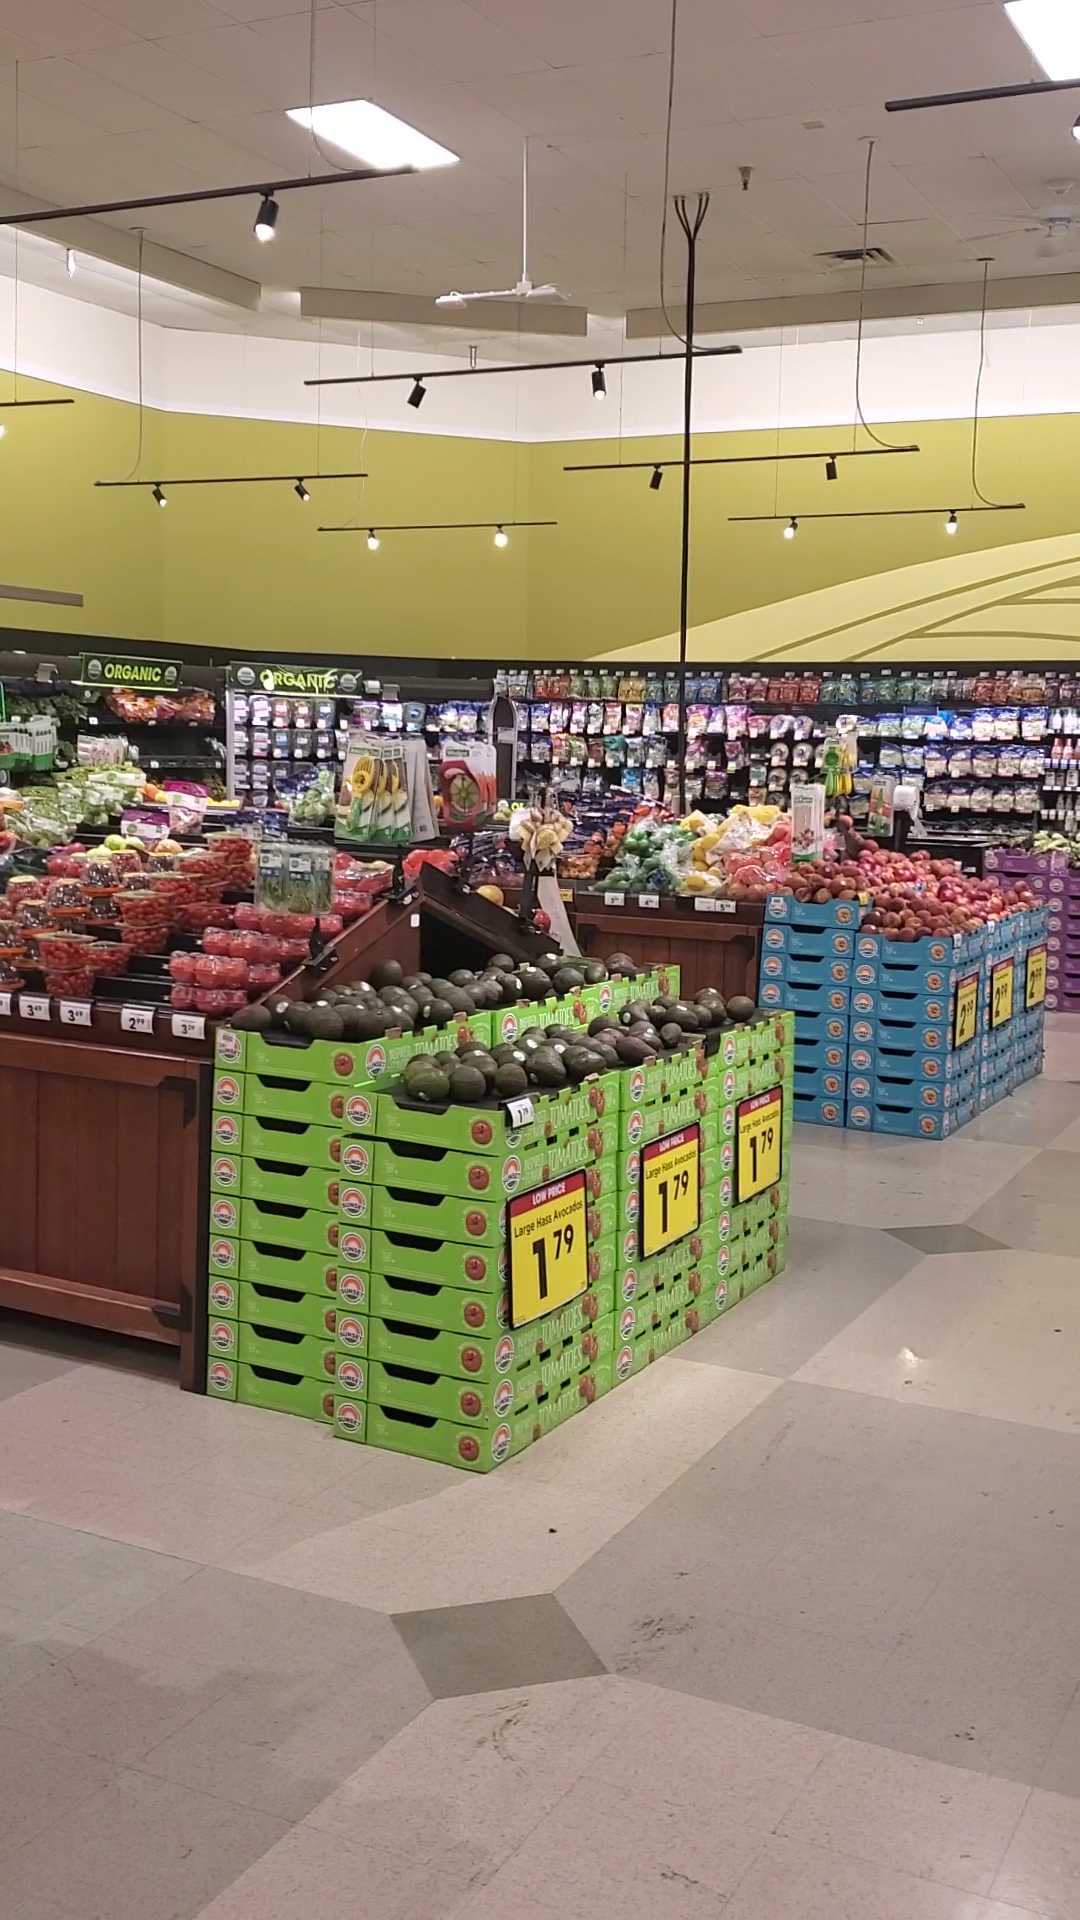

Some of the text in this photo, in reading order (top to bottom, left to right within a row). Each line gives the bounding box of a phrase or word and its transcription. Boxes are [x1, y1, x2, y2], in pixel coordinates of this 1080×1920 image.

[104, 662, 162, 682] ORGANIC
[347, 1110, 370, 1120] SUNSET
[550, 1094, 590, 1129] TOMATOES
[548, 1136, 589, 1172] TOMATOES
[659, 1132, 685, 1152] LOW PRICE
[646, 1166, 660, 1180] Large
[662, 1162, 673, 1173] Hass
[674, 1150, 697, 1167] Avocados
[532, 1182, 567, 1206] LOW PRICE
[514, 1200, 583, 1238] Large Hass Avocados
[341, 1246, 366, 1256] SUNSET
[541, 1304, 582, 1345] TOMATOES
[541, 1347, 583, 1386] TOMATOES
